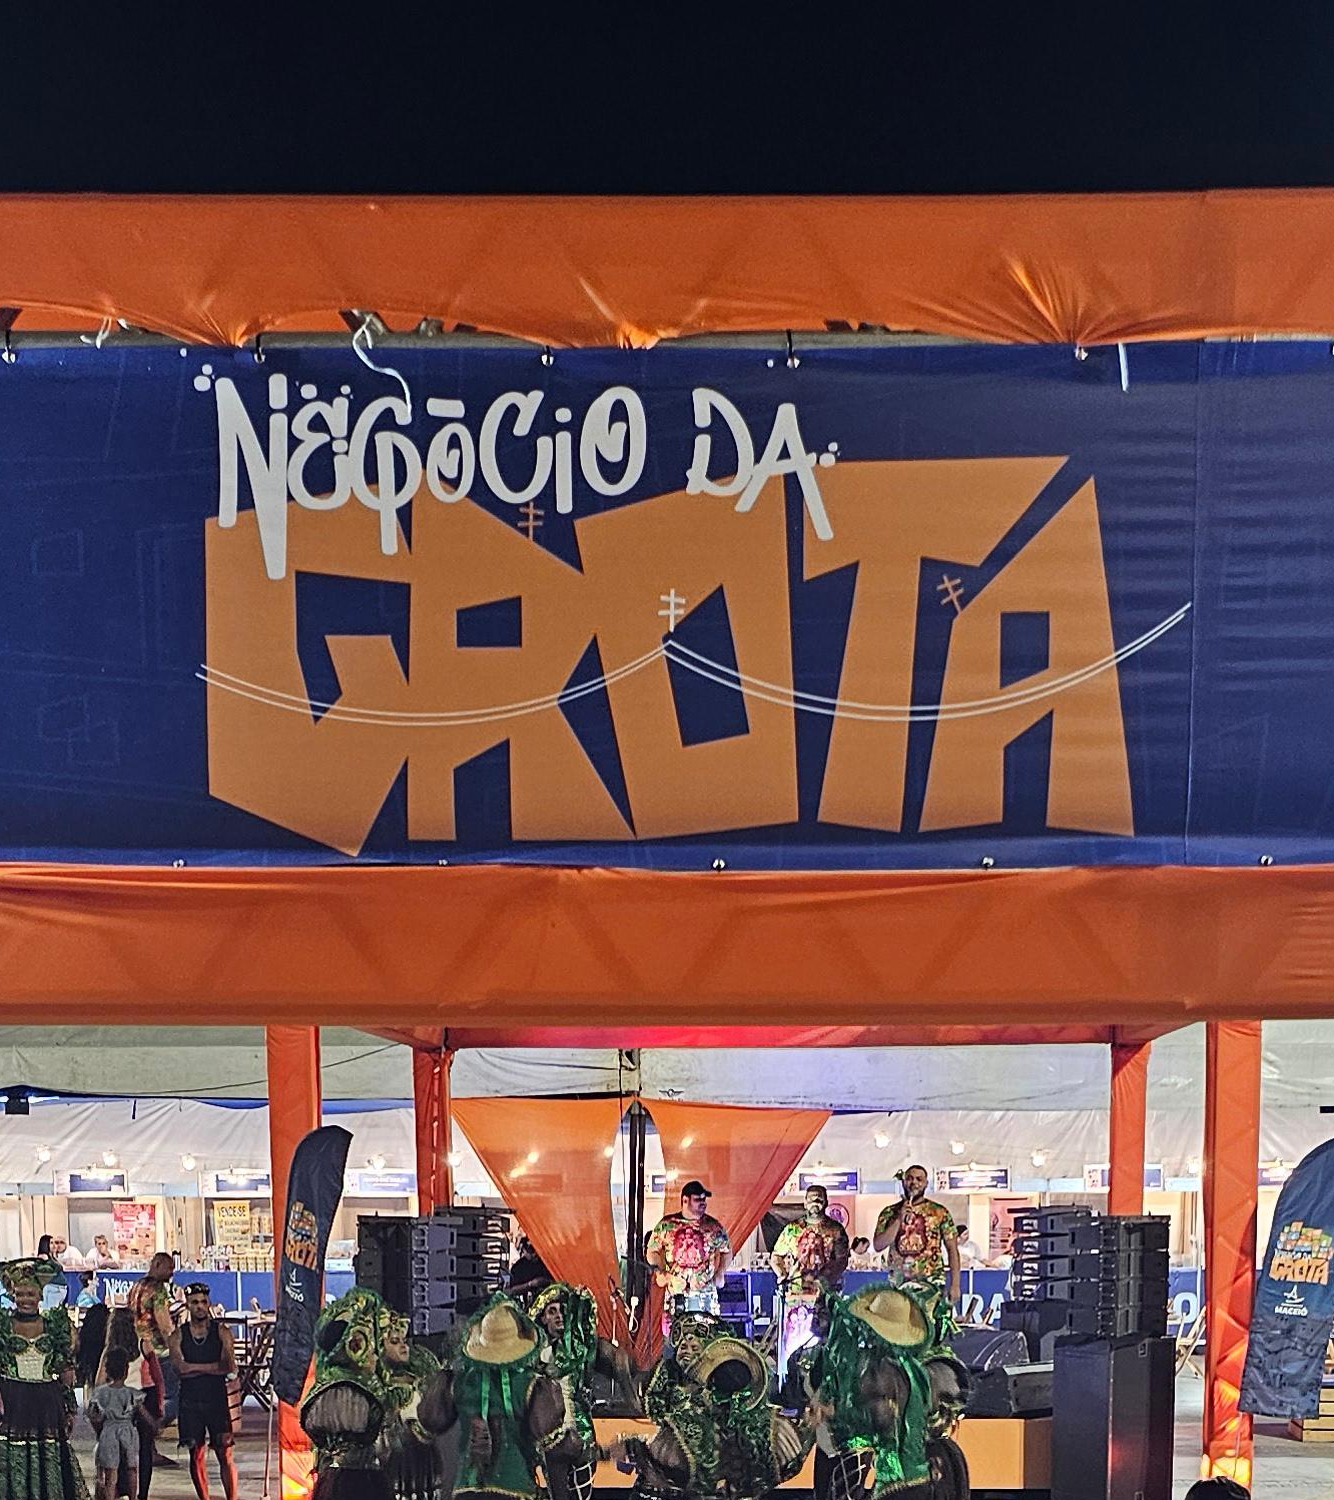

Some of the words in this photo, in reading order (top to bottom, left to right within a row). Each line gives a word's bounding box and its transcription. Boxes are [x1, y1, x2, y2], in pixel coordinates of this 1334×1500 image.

[687, 387, 838, 541] DA
[204, 455, 1135, 857] GROTA
[1269, 1258, 1329, 1285] GROTA
[1274, 1306, 1308, 1316] MACEIÓ
